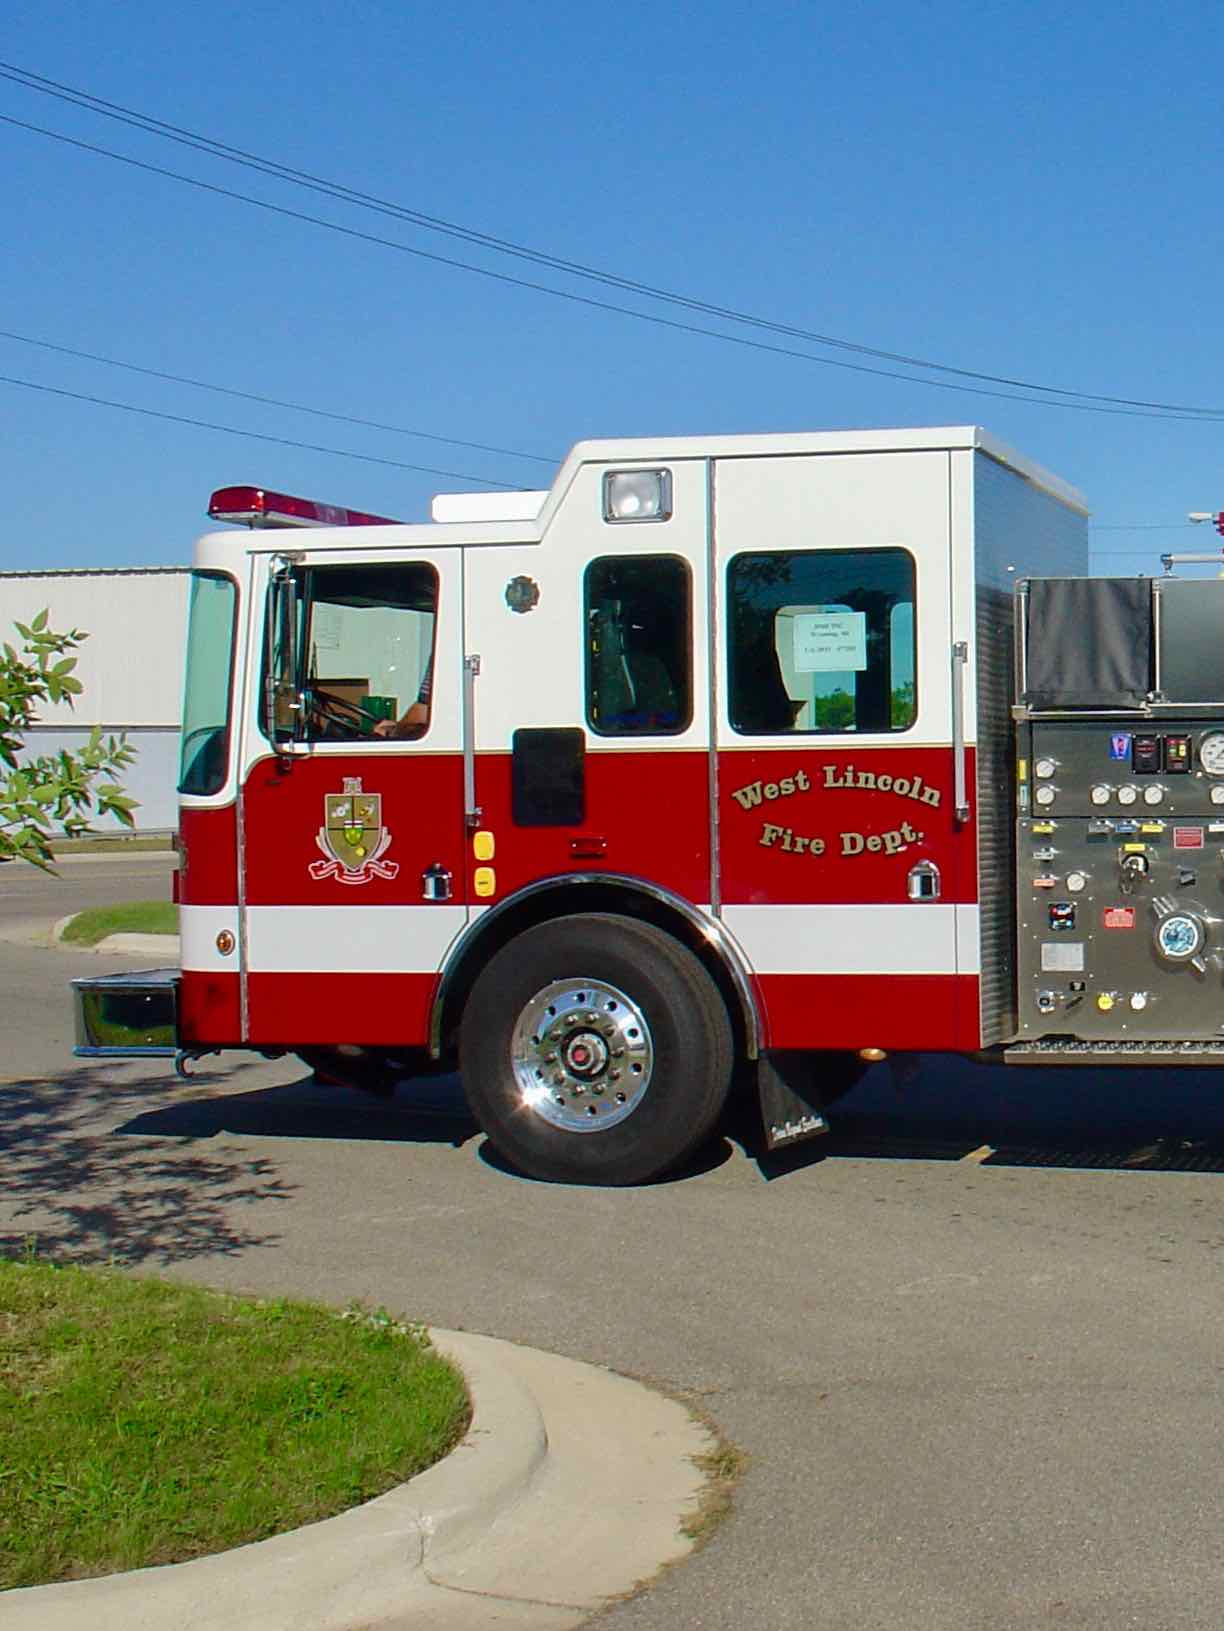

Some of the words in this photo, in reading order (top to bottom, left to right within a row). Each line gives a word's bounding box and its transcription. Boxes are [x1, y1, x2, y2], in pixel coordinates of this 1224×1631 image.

[732, 770, 810, 810] West
[823, 765, 941, 807] Lincoln
[759, 823, 825, 855] Fire
[840, 821, 925, 855] Dept.
